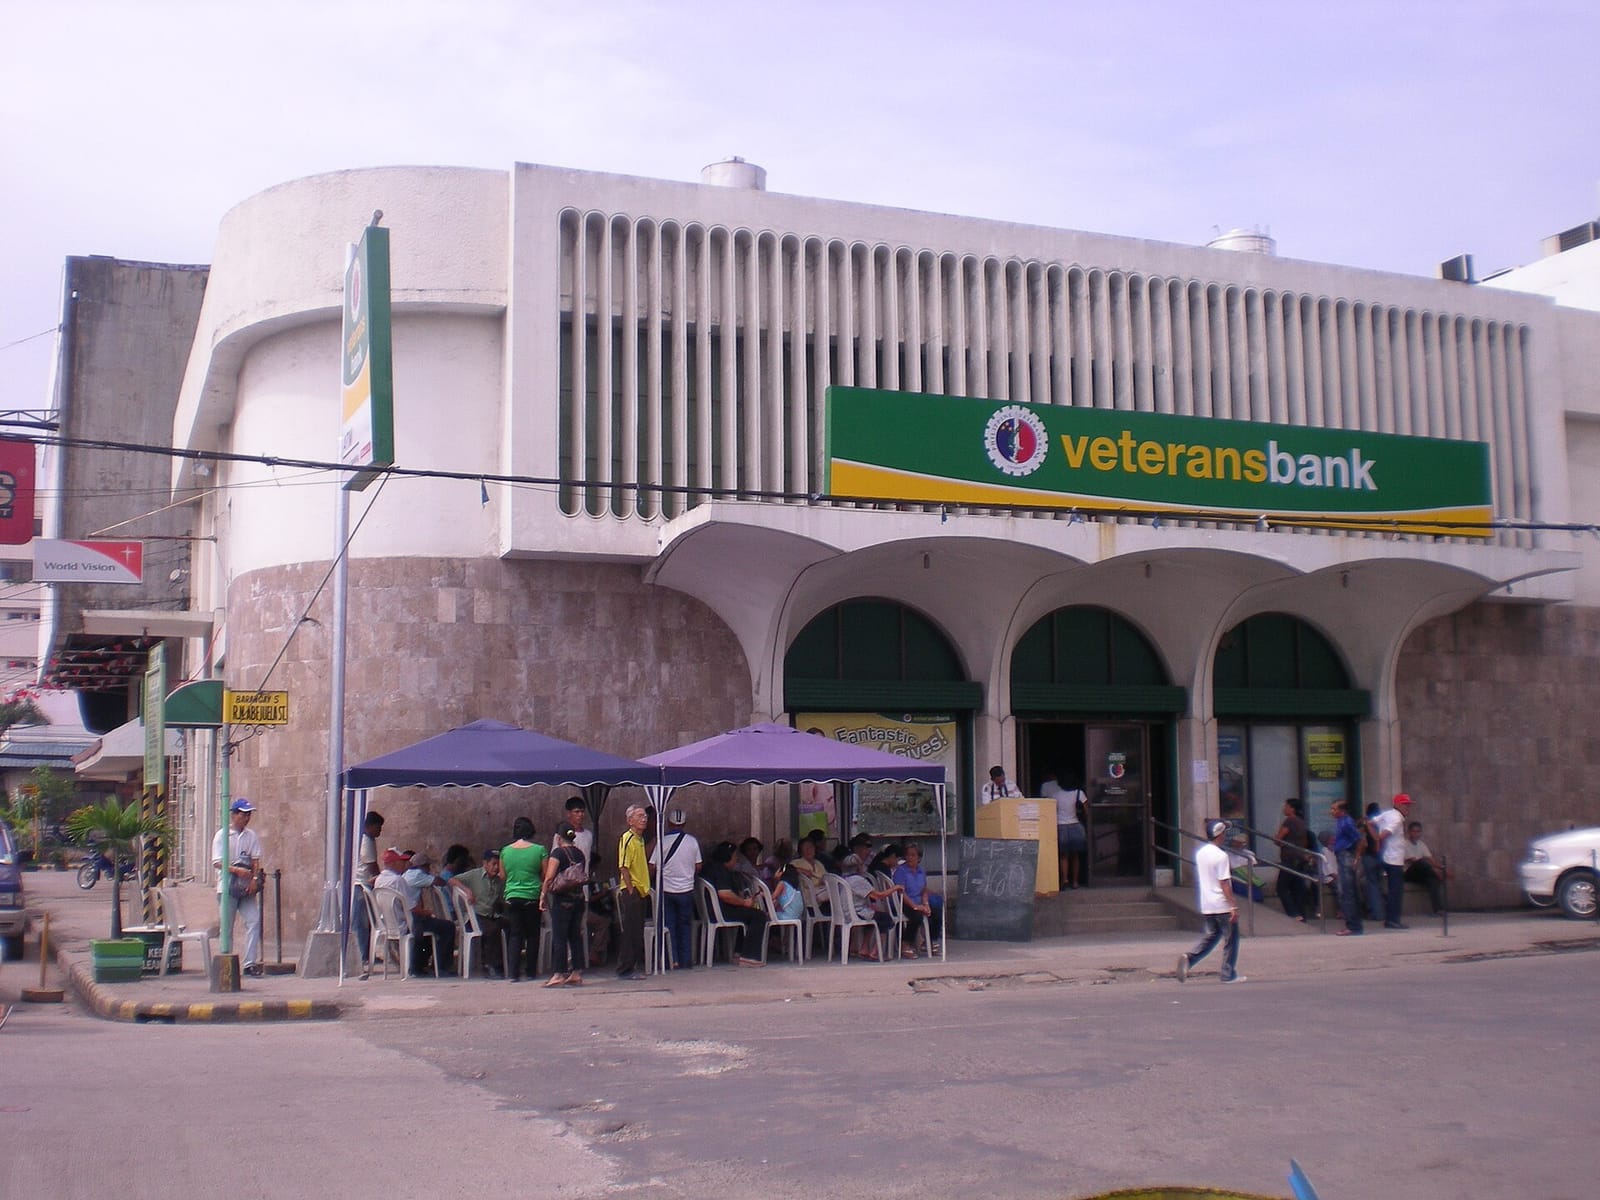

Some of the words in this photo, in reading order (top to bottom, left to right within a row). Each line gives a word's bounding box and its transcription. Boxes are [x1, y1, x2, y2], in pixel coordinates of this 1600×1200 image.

[1061, 430, 1378, 490] veteransbank
[44, 562, 78, 570] World
[81, 562, 116, 571] Vision
[236, 695, 271, 703] BARANGAY
[835, 724, 918, 745] Fantastic
[893, 725, 949, 760] Gives!
[148, 947, 163, 957] KEE
